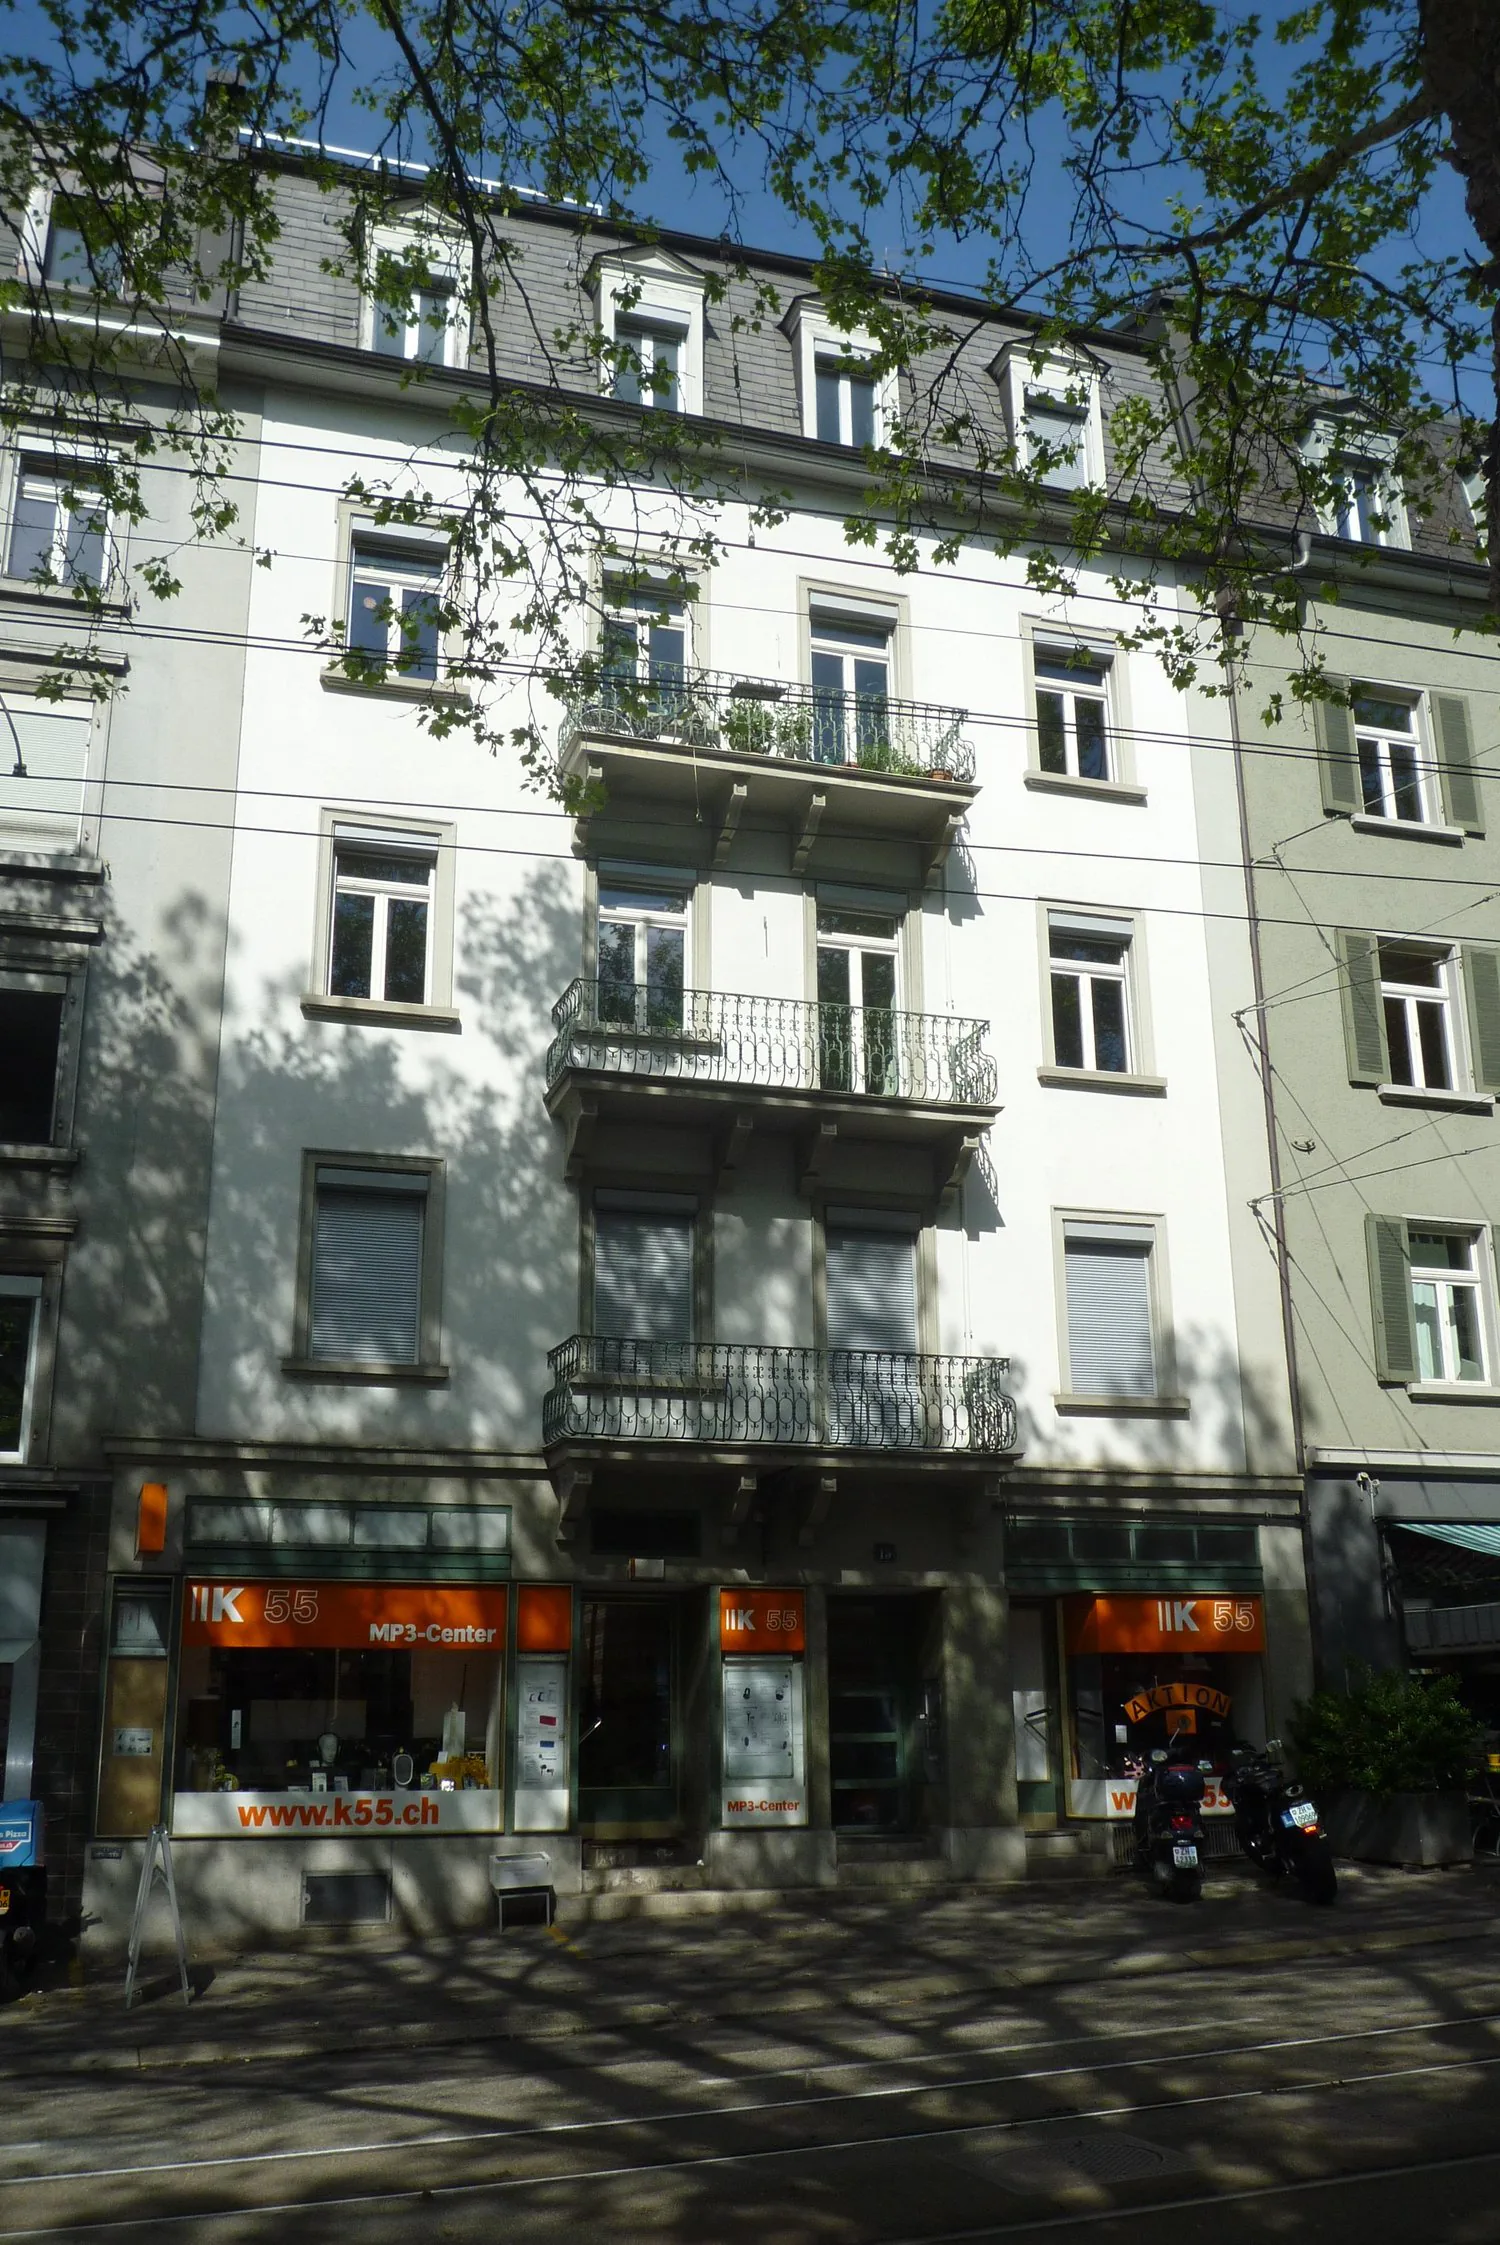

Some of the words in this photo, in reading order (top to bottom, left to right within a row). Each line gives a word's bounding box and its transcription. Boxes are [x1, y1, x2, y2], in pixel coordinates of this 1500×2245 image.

[264, 1589, 319, 1623] 55
[1213, 1602, 1255, 1632] 55
[369, 1623, 497, 1643] MP3-Center
[766, 1610, 798, 1631] 55
[1131, 1685, 1229, 1720] AKTION
[237, 1797, 440, 1827] www.k55.ch
[727, 1800, 800, 1812] MP3-Center
[5, 1830, 27, 1838] Pizza
